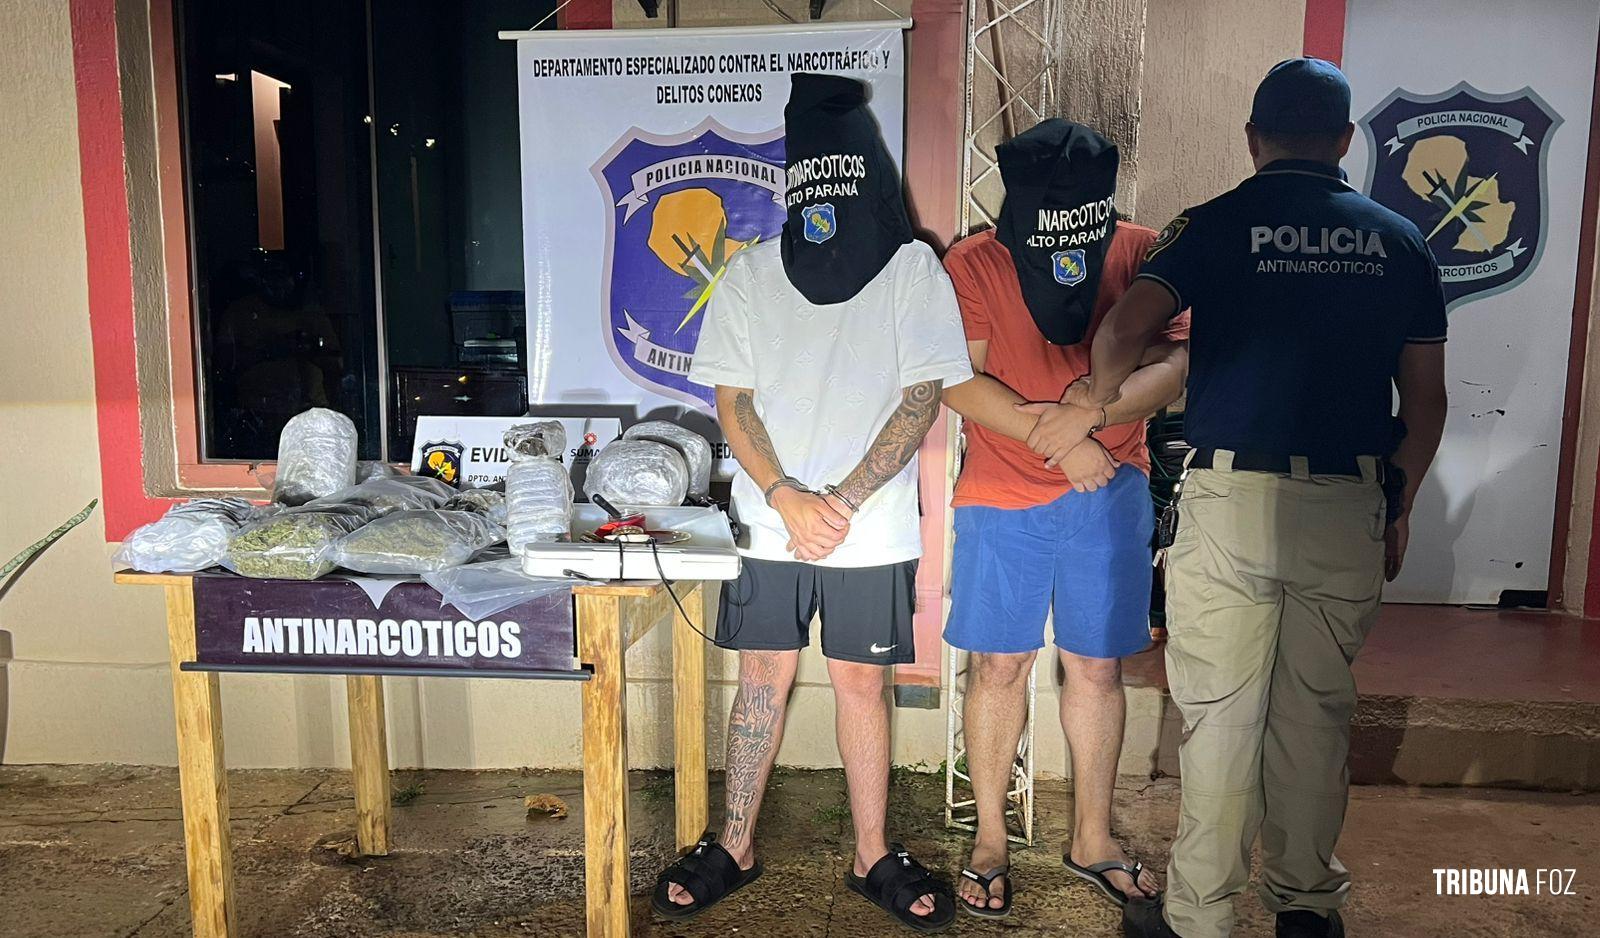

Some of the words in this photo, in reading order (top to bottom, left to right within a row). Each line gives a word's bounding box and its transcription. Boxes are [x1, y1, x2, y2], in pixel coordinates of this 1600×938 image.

[533, 57, 623, 78] DEPARTAMENTO
[626, 55, 715, 76] ESPECIALIZADO
[719, 53, 767, 74] CONTRA
[769, 52, 784, 72] EL
[882, 50, 891, 70] Y
[656, 84, 704, 104] DELITOS
[707, 83, 762, 103] CONEXOS
[1417, 113, 1457, 128] POLICIA
[1459, 112, 1508, 128] NACIONAL
[646, 159, 702, 187] POLICIA
[706, 158, 777, 185] NACIONAL
[805, 179, 859, 201] PARANÁ
[1250, 225, 1387, 258] POLICIA
[1256, 259, 1384, 277] ANTINARCOTICOS
[242, 616, 522, 659] ANTINARCOTICOS
